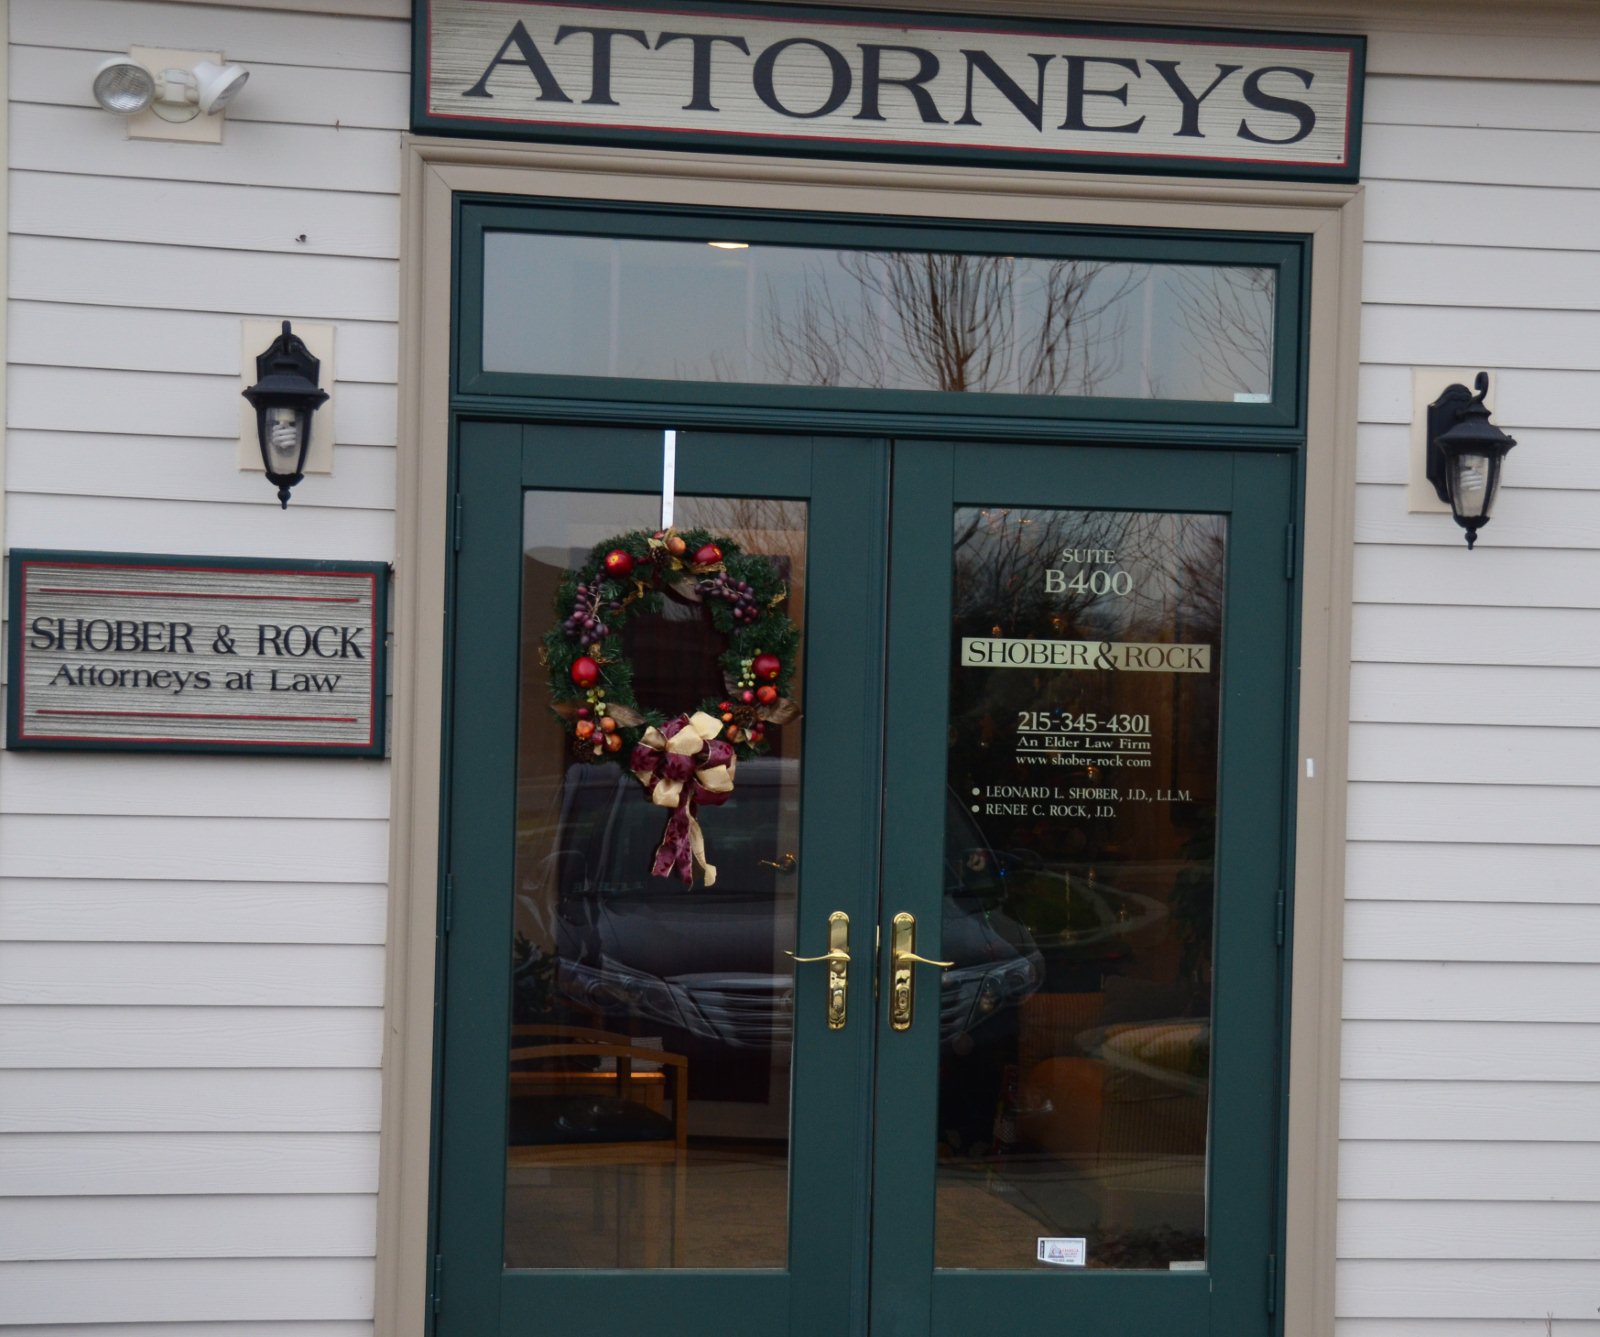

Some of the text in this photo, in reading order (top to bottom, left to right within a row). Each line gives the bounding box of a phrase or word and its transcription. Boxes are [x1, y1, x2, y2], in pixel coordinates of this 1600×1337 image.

[461, 19, 1316, 145] ATTORNEYS
[1062, 548, 1116, 564] SUITE
[1044, 569, 1133, 595] B400
[30, 616, 365, 658] SHOBER & ROCK
[968, 640, 1206, 670] SHOBER & ROCK
[49, 663, 341, 694] Attorneys at Law
[1018, 712, 1151, 733] 215-345-4301
[1018, 736, 1150, 749] An Elder Law Firm
[986, 786, 1192, 802] LEONARD L. SHOBER, J.D., L.L.M.
[986, 804, 1116, 818] RENEE C. ROCK, J.D.
